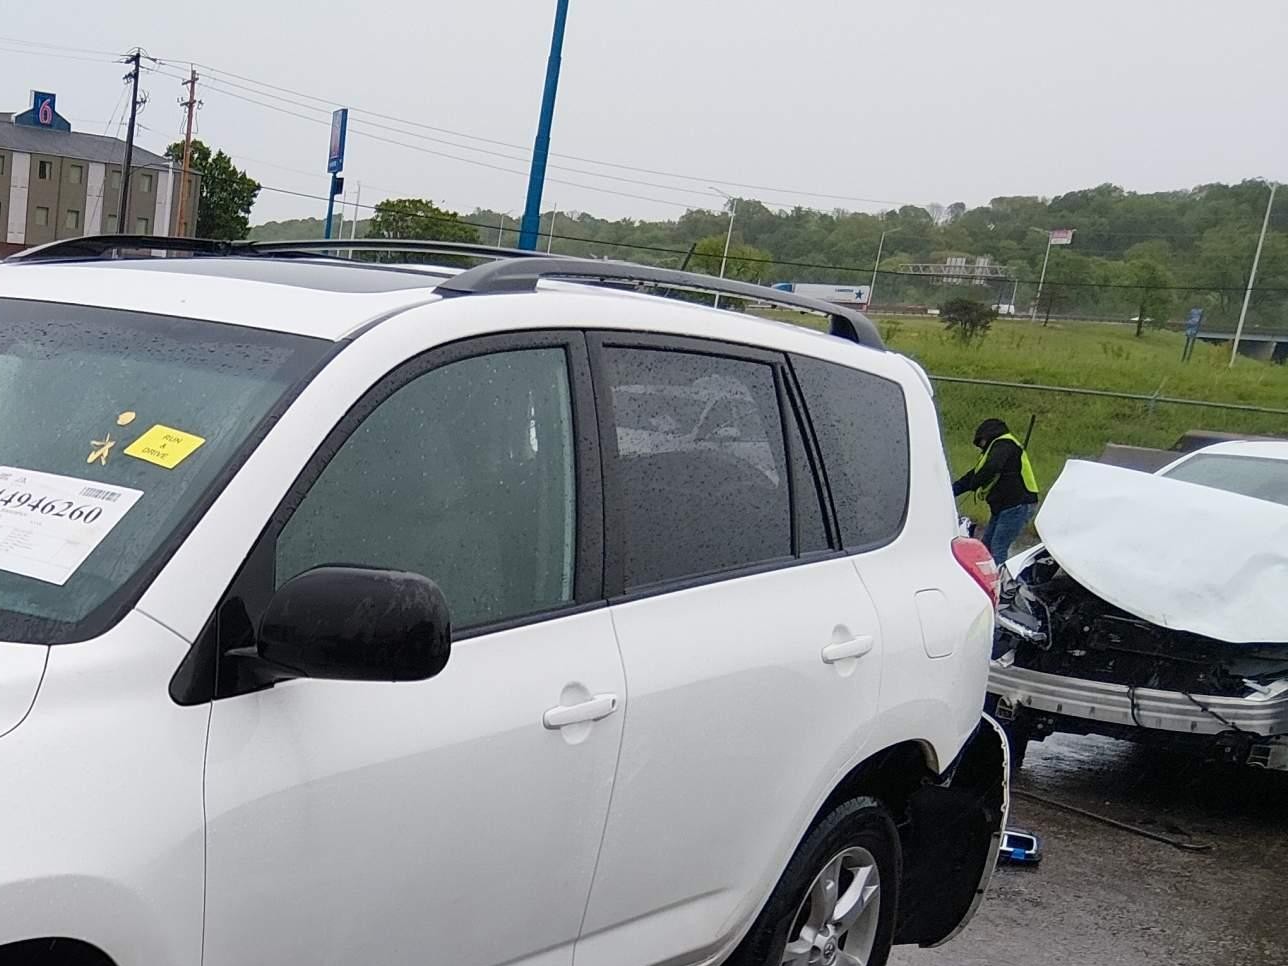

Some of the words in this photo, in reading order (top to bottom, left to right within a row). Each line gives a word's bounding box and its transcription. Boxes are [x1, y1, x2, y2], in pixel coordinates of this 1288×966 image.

[39, 98, 52, 125] 6
[163, 434, 183, 444] RUN
[142, 447, 169, 460] DRIVE
